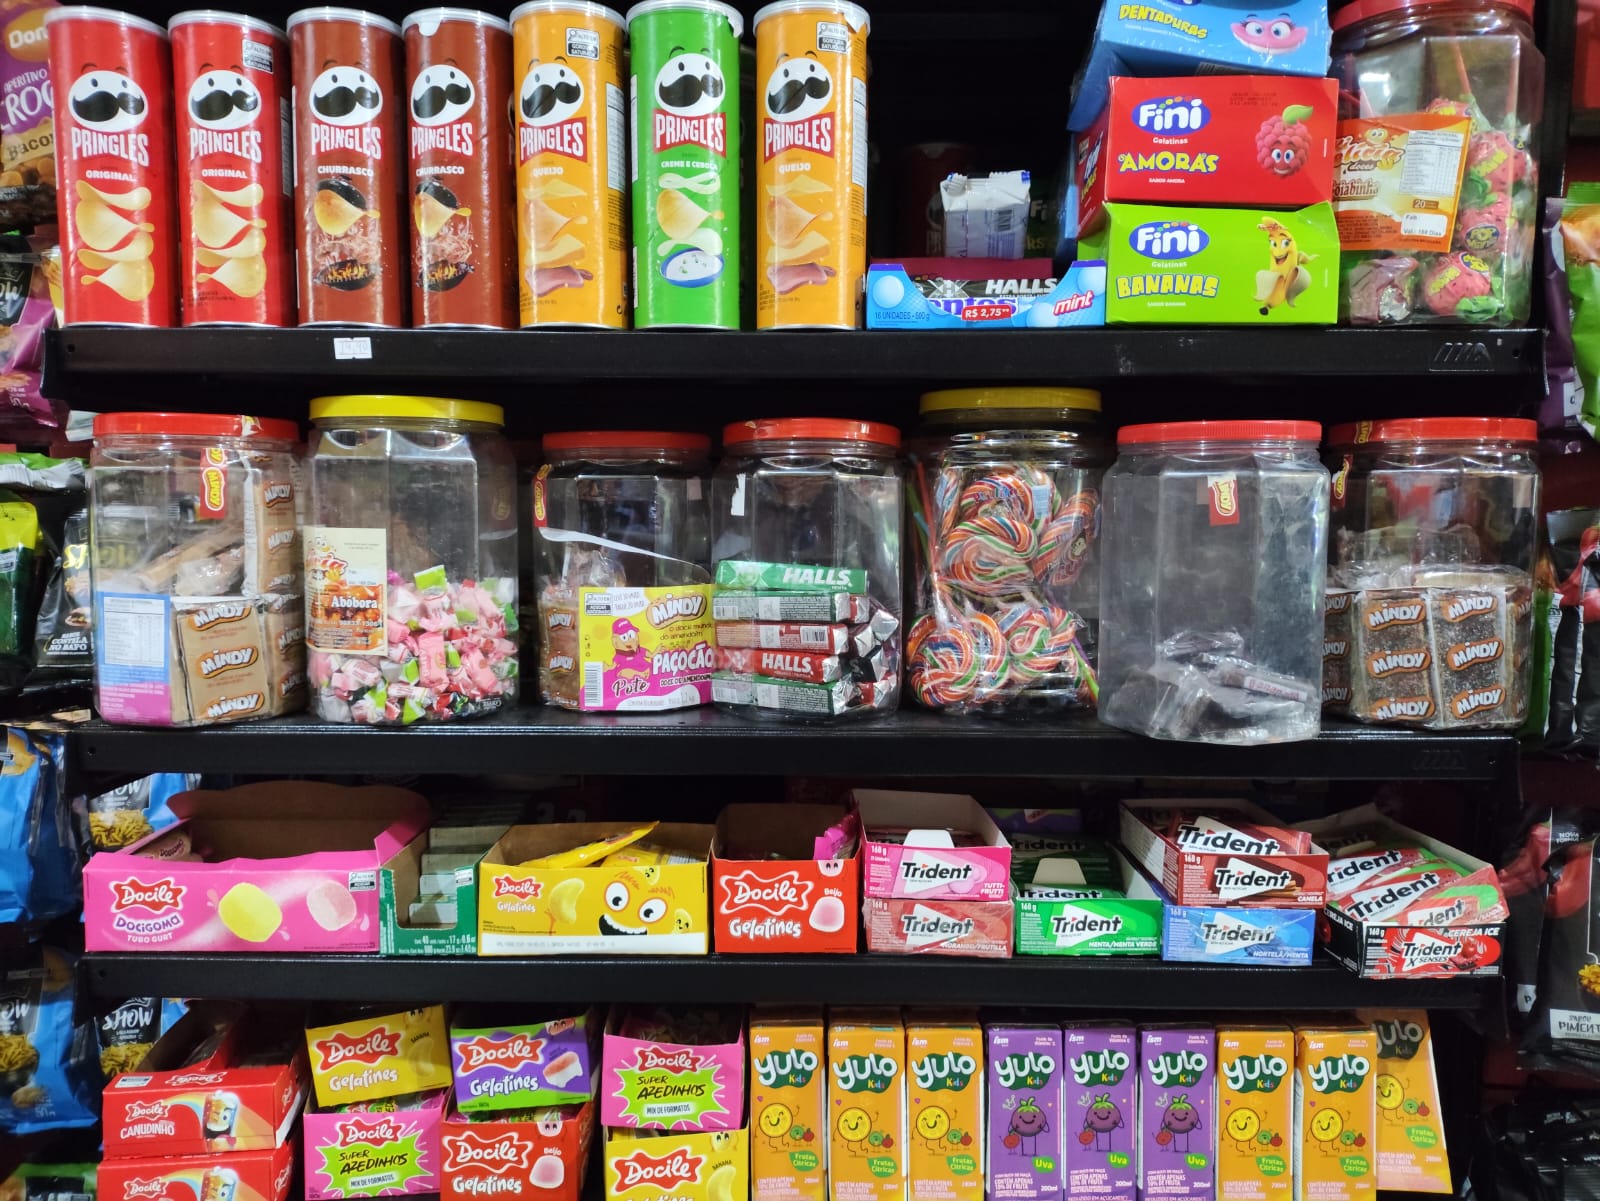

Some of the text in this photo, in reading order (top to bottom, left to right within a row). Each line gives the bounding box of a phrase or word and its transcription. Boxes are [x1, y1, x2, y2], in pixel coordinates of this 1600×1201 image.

[1119, 4, 1208, 39] DENTADURAS
[4, 68, 48, 94] APERITIVO
[1138, 98, 1203, 132] Fini
[311, 123, 382, 160] PRINGLES
[411, 122, 474, 157] PRINGLES
[520, 120, 585, 163] PRINGLES
[655, 113, 725, 151] PRINGLES
[764, 117, 832, 157] PRINGLES
[1152, 136, 1189, 146] Gelatinas
[71, 126, 149, 167] PRINGLES
[190, 127, 263, 164] PRINGLES
[317, 165, 374, 178] CHURRASCO
[415, 165, 465, 177] CHURRASCO
[532, 166, 564, 177] QUEIJO
[660, 160, 685, 169] CREME
[686, 161, 691, 169] E
[778, 163, 812, 174] QUEIJO
[1117, 151, 1220, 174] AMORAS
[85, 169, 136, 182] ORIGINAL
[201, 168, 248, 179] ORIGINAL
[1414, 200, 1427, 210] 20
[1137, 223, 1202, 255] Fini
[985, 277, 1058, 295] HALLS
[1116, 274, 1220, 299] BANANAS
[1053, 290, 1095, 317] mint
[782, 567, 853, 586] HALLS
[331, 595, 378, 609] Abóbora
[651, 592, 702, 625] MINDY
[1448, 597, 1493, 619] MINDY
[193, 604, 246, 628] MINDY
[1368, 603, 1422, 627] MINDY
[200, 648, 253, 675] MINDY
[652, 642, 715, 678] PAÇOCÃO
[761, 652, 814, 675] HALLS
[1372, 651, 1425, 675] MINDY
[1453, 642, 1499, 668] MINDY
[612, 677, 648, 697] Pote
[206, 695, 259, 718] MINDY
[1376, 699, 1430, 720] MINDY
[1457, 689, 1502, 715] MINDY
[1177, 824, 1281, 855] Trident
[902, 861, 972, 879] Trident
[1215, 868, 1290, 887] Trident
[121, 884, 174, 904] Docile
[498, 878, 537, 896] Docile
[734, 880, 798, 904] Docile
[823, 887, 843, 897] Beijo
[1019, 888, 1103, 900] Trident
[1346, 871, 1441, 920] Trident
[497, 900, 537, 914] Gelatines
[115, 914, 181, 933] DOCIGOMA
[729, 918, 802, 940] Gelatines
[903, 915, 974, 934] Trident
[1053, 914, 1122, 933] Trident
[1202, 922, 1275, 942] Trident
[1447, 926, 1500, 937] CEREJA ICE
[127, 932, 173, 943] TUBO GURT
[1402, 942, 1462, 958] Trident
[1417, 956, 1448, 964] SENSES
[102, 1006, 154, 1033] SHOW
[326, 1039, 391, 1063] Docile
[469, 1042, 533, 1066] Docile
[644, 1052, 693, 1069] Docile
[753, 1048, 819, 1087] yulo
[832, 1052, 898, 1091] yulo
[911, 1051, 977, 1090] yulo
[994, 1051, 1056, 1088] yulo
[1069, 1048, 1130, 1085] yulo
[1147, 1049, 1208, 1088] yulo
[1222, 1053, 1289, 1091] yulo
[1307, 1053, 1371, 1092] yulo
[329, 1070, 399, 1092] Gelatines
[470, 1074, 539, 1098] Gelatines
[636, 1074, 669, 1086] SUPER
[788, 1073, 806, 1084] Kids
[867, 1079, 885, 1090] Kids
[946, 1077, 964, 1088] Kids
[1026, 1075, 1044, 1087] Kids
[1101, 1073, 1119, 1083] Kids
[1178, 1074, 1196, 1084] Kids
[1256, 1079, 1275, 1089] Kids
[1339, 1079, 1358, 1089] Kids
[636, 1083, 706, 1100] AZEDINHOS
[132, 1105, 163, 1119] Docile
[646, 1104, 691, 1114] MIX DE FORMATOS
[119, 1123, 175, 1140] CANUDINHO
[345, 1125, 394, 1142] Docile
[1410, 1128, 1435, 1138] Frutas
[338, 1149, 370, 1163] SUPER
[456, 1140, 519, 1163] Docile
[543, 1147, 562, 1156] Beijo
[794, 1153, 816, 1162] Frutas
[952, 1156, 974, 1165] Frutas
[1109, 1155, 1128, 1165] Uva
[1187, 1156, 1206, 1166] Uva
[340, 1154, 409, 1176] AZEDINHOS
[623, 1155, 692, 1185] Docile
[873, 1158, 895, 1167] Frutas
[1035, 1159, 1053, 1170] Uva
[1261, 1157, 1283, 1166] Frutas
[1345, 1158, 1367, 1167] Frutas
[130, 1181, 161, 1194] Docile
[350, 1174, 395, 1188] MIX DE FORMATOS
[453, 1175, 523, 1195] Gelatines
